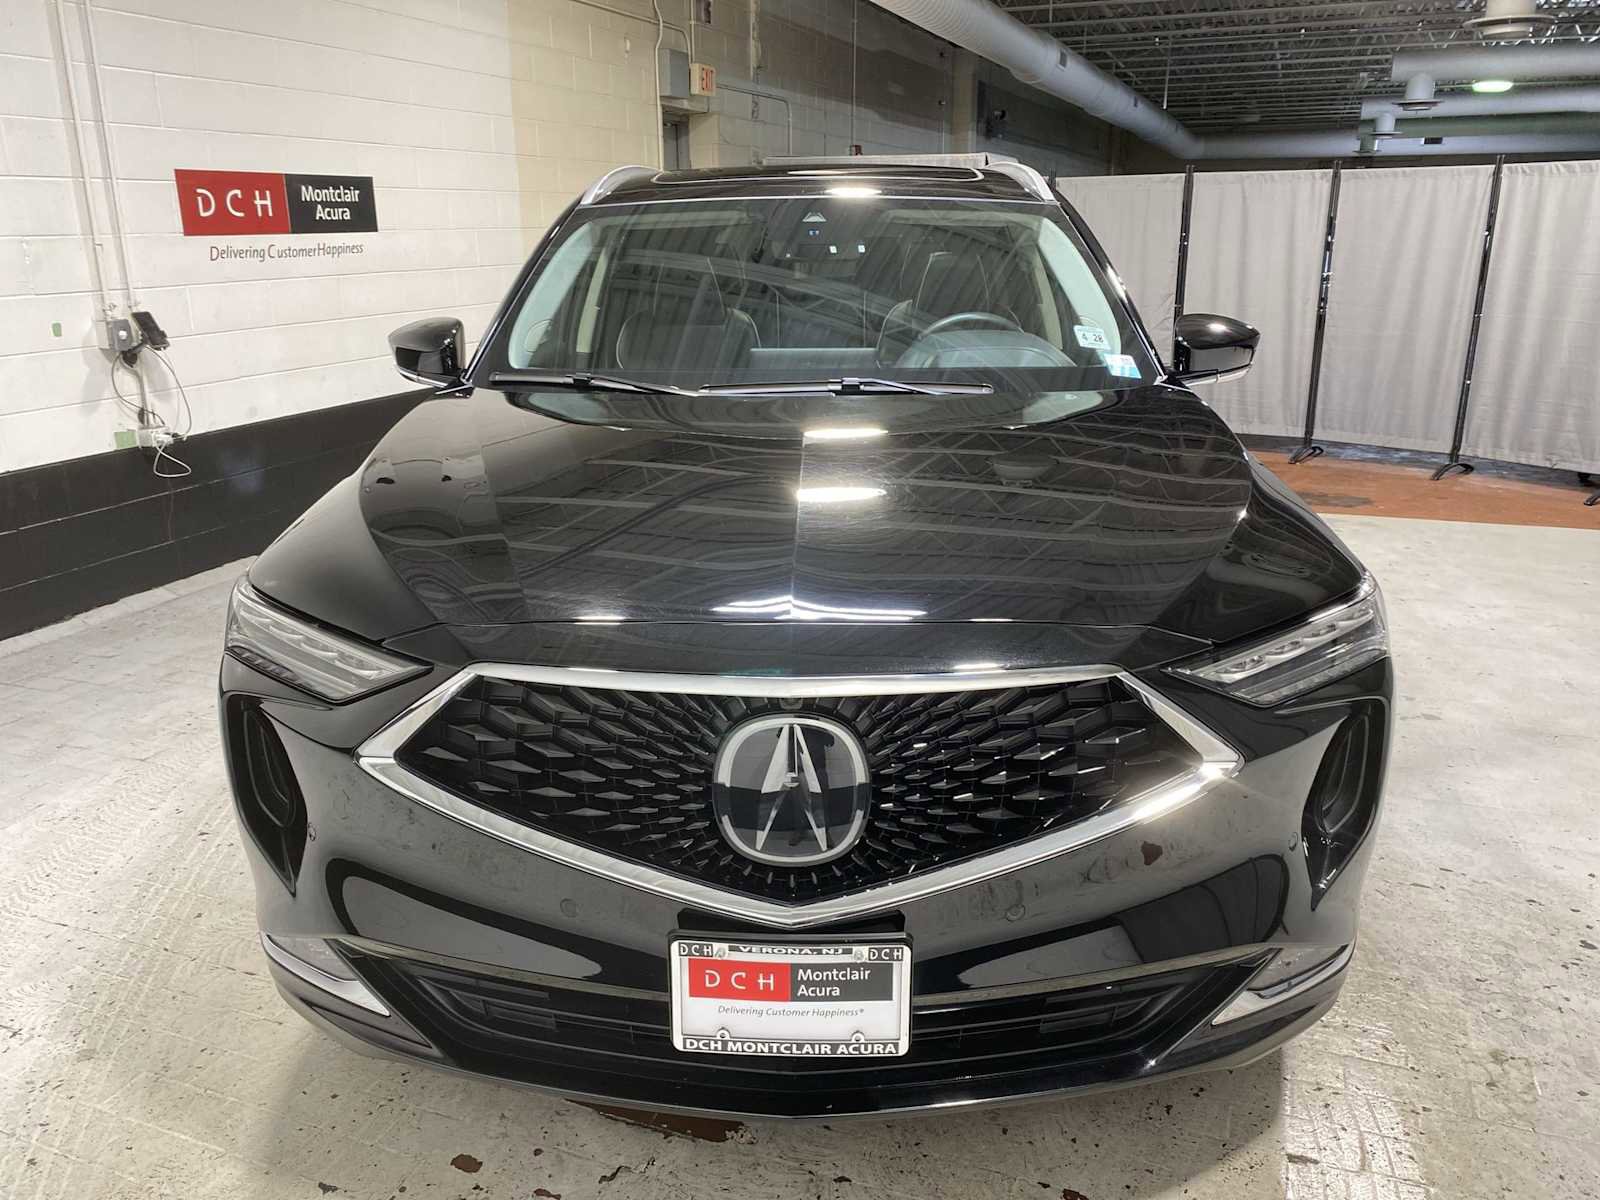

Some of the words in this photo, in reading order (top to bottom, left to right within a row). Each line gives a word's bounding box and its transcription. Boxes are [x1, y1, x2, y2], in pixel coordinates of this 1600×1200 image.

[702, 67, 714, 91] EXIT
[301, 185, 360, 202] Montclair
[315, 204, 351, 220] Acura
[210, 245, 265, 262] Delivering
[797, 967, 871, 981] Montclair
[797, 984, 840, 997] Acura
[718, 1004, 764, 1018] Delivering
[766, 1007, 810, 1017] Customer
[685, 1038, 722, 1051] DCH
[727, 1041, 832, 1055] MONTCLAIR
[836, 1043, 897, 1055] ACURA
